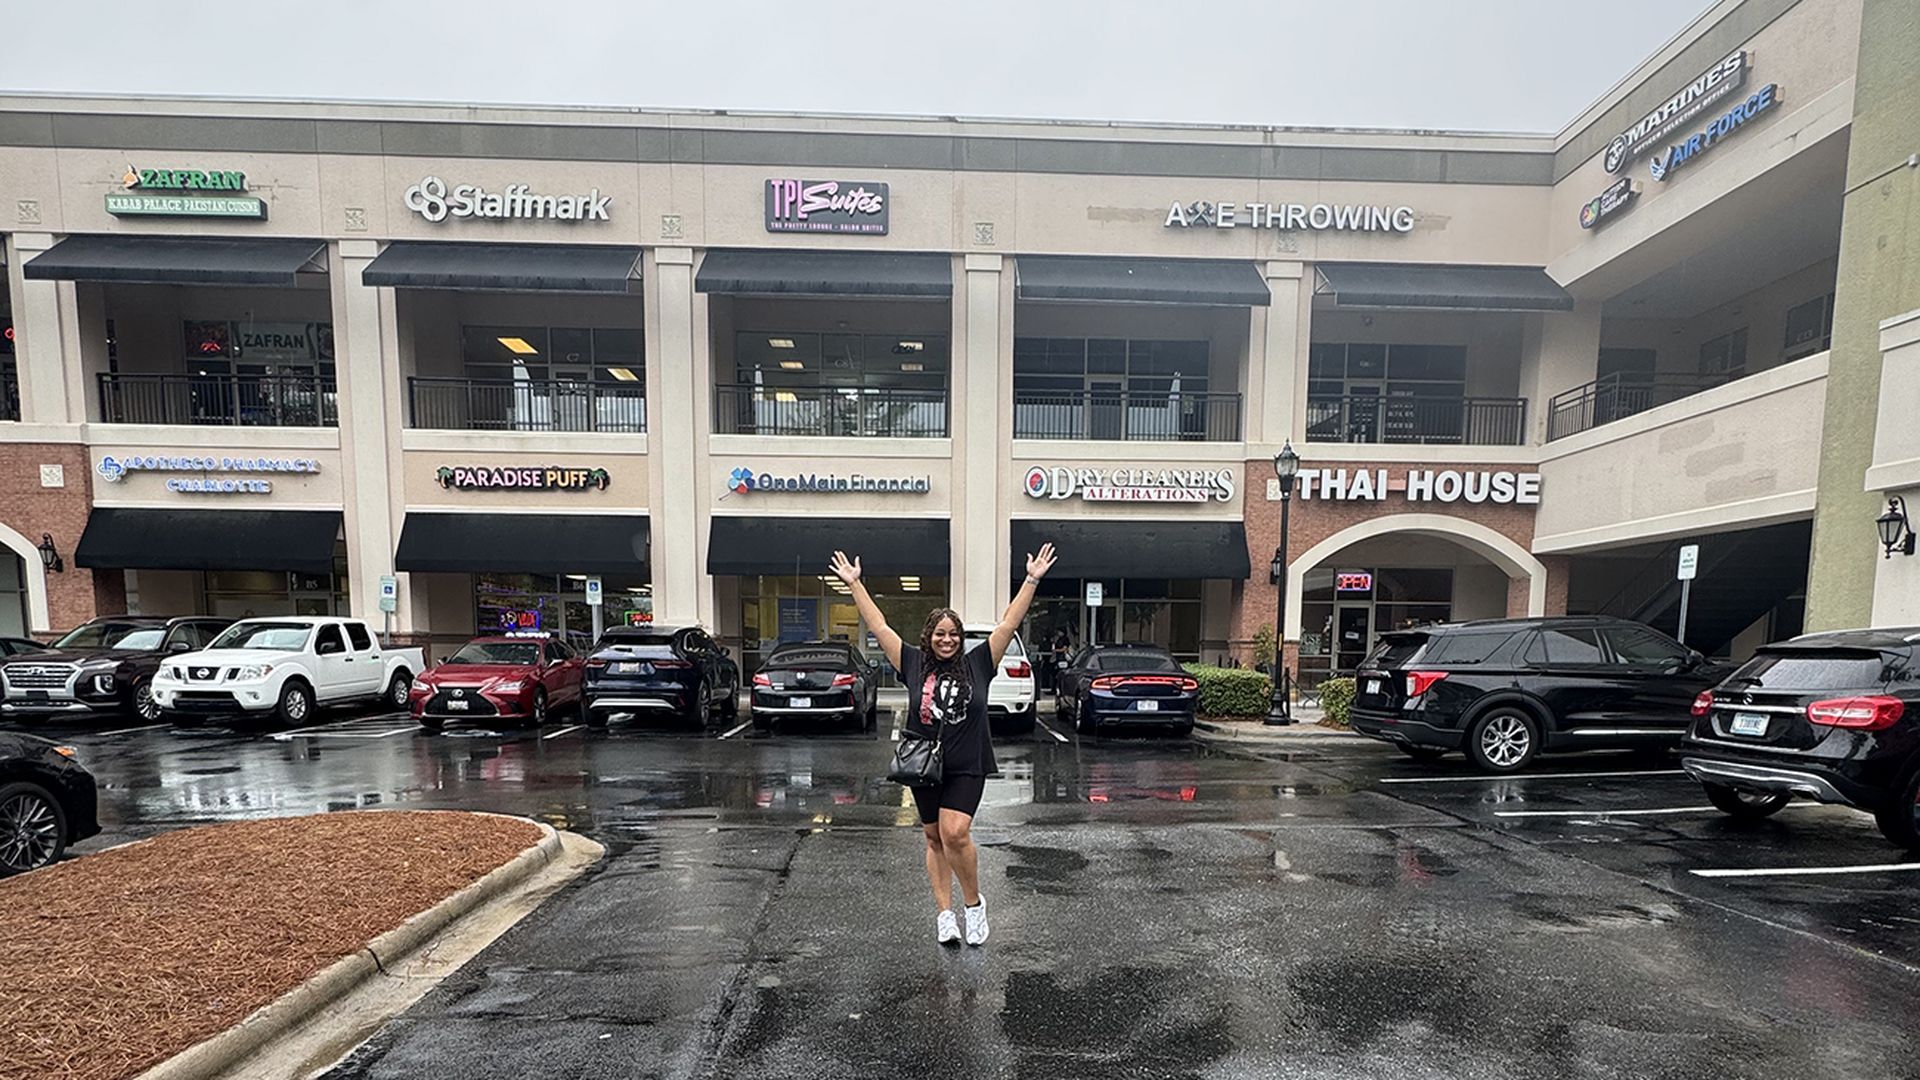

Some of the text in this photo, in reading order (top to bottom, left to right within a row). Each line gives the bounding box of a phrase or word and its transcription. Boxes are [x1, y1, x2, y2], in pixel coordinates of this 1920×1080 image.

[1627, 51, 1742, 146] MARINES
[1663, 103, 1701, 135] SELECTION
[1671, 85, 1774, 168] AIR FORCE
[140, 168, 245, 190] ZAFRAN
[108, 198, 142, 210] KABAB
[143, 199, 182, 211] PALACE
[451, 184, 613, 220] Staffmark
[771, 180, 883, 219] TPL Suites
[1246, 202, 1415, 232] THROWING
[243, 334, 305, 348] ZAFRAN
[123, 456, 317, 473] APOTHECO PHARMACY
[167, 479, 270, 493] CHARLOTTE
[454, 470, 588, 487] PARADISE PUFF
[758, 473, 931, 491] OneMain Financial
[1111, 468, 1236, 503] CLEANERS
[1297, 468, 1542, 504] THAI HOUSE
[1086, 488, 1207, 500] ALTERATIONS
[1338, 575, 1369, 589] OPEN
